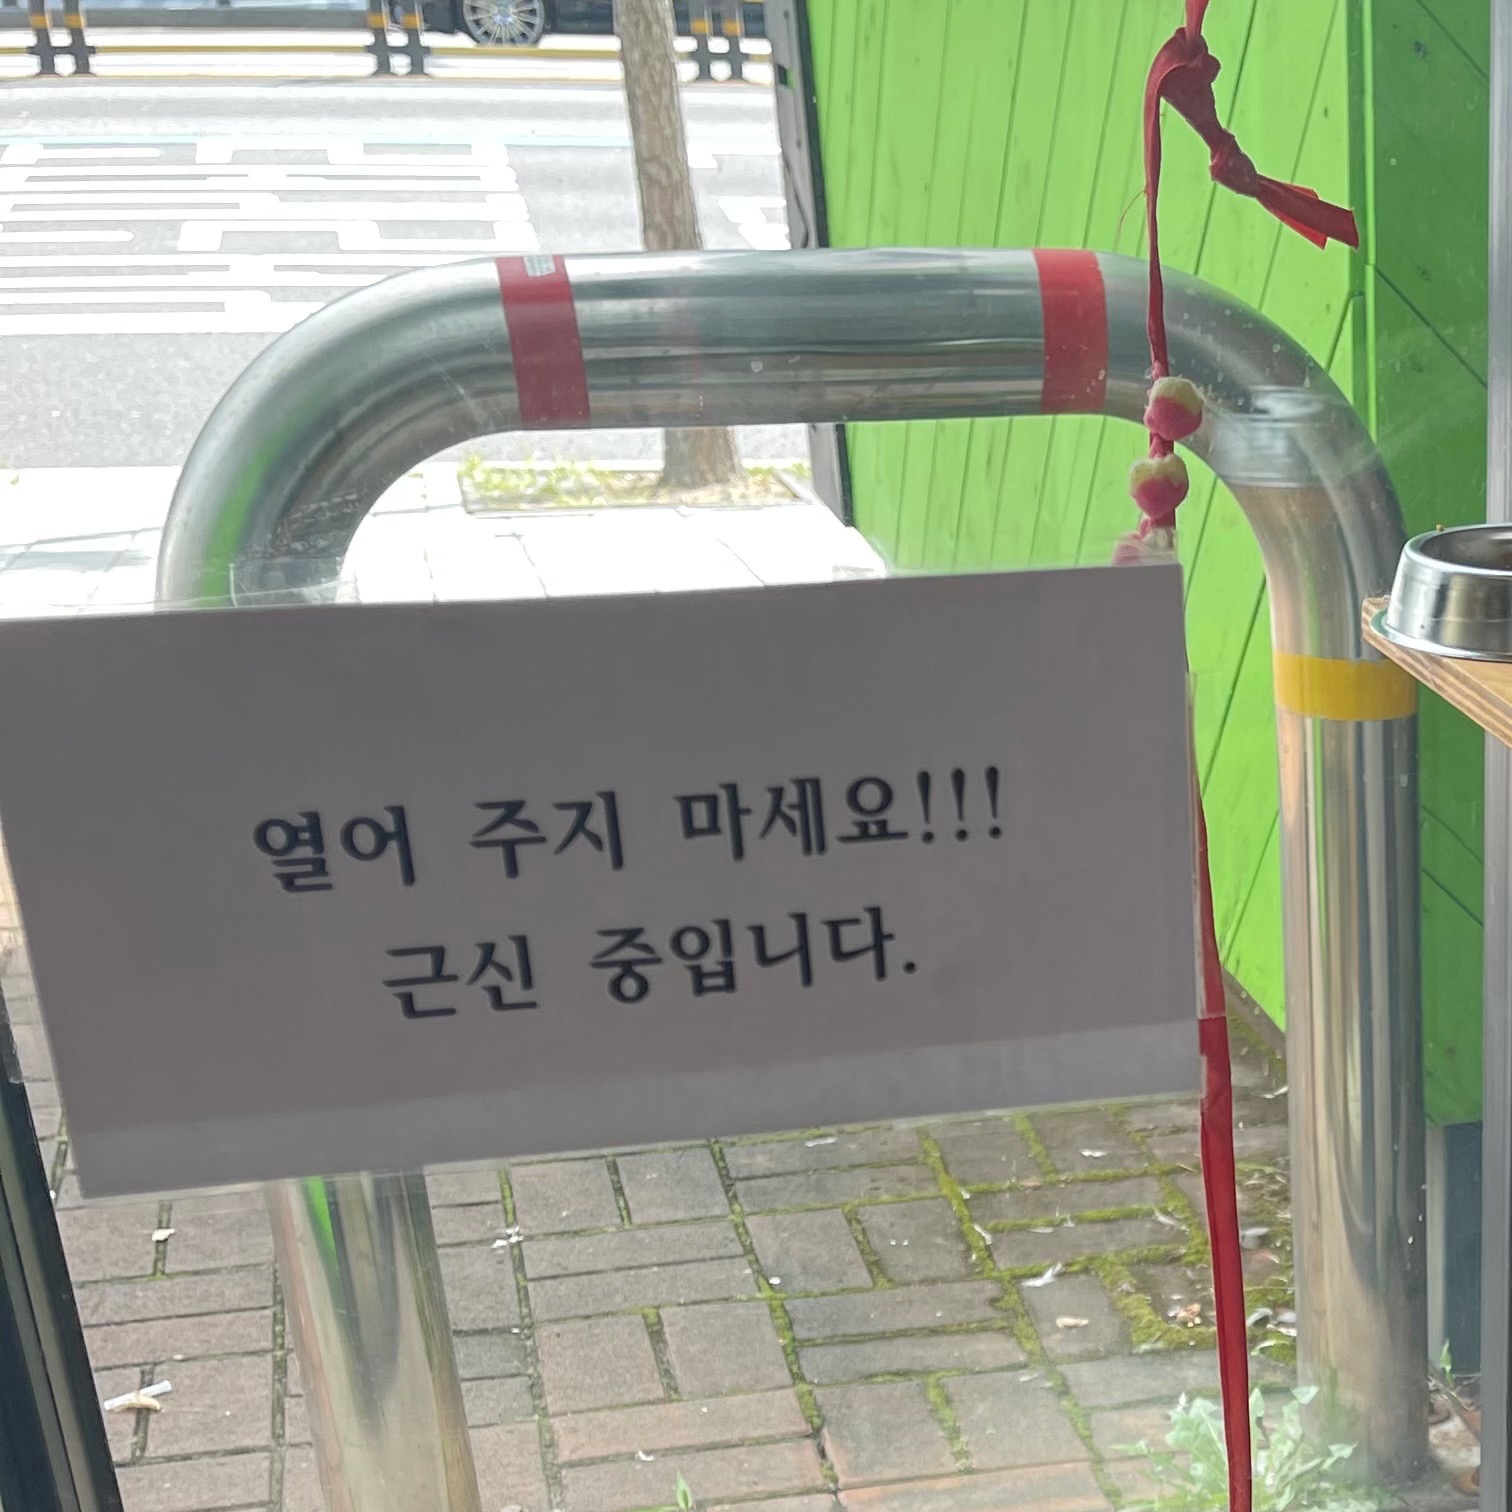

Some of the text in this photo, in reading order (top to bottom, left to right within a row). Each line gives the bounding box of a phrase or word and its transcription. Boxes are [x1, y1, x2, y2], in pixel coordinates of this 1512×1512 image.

[253, 766, 1003, 893] 열어 주지 마세요!!!
[382, 905, 917, 1020] 근신 중입니다.
